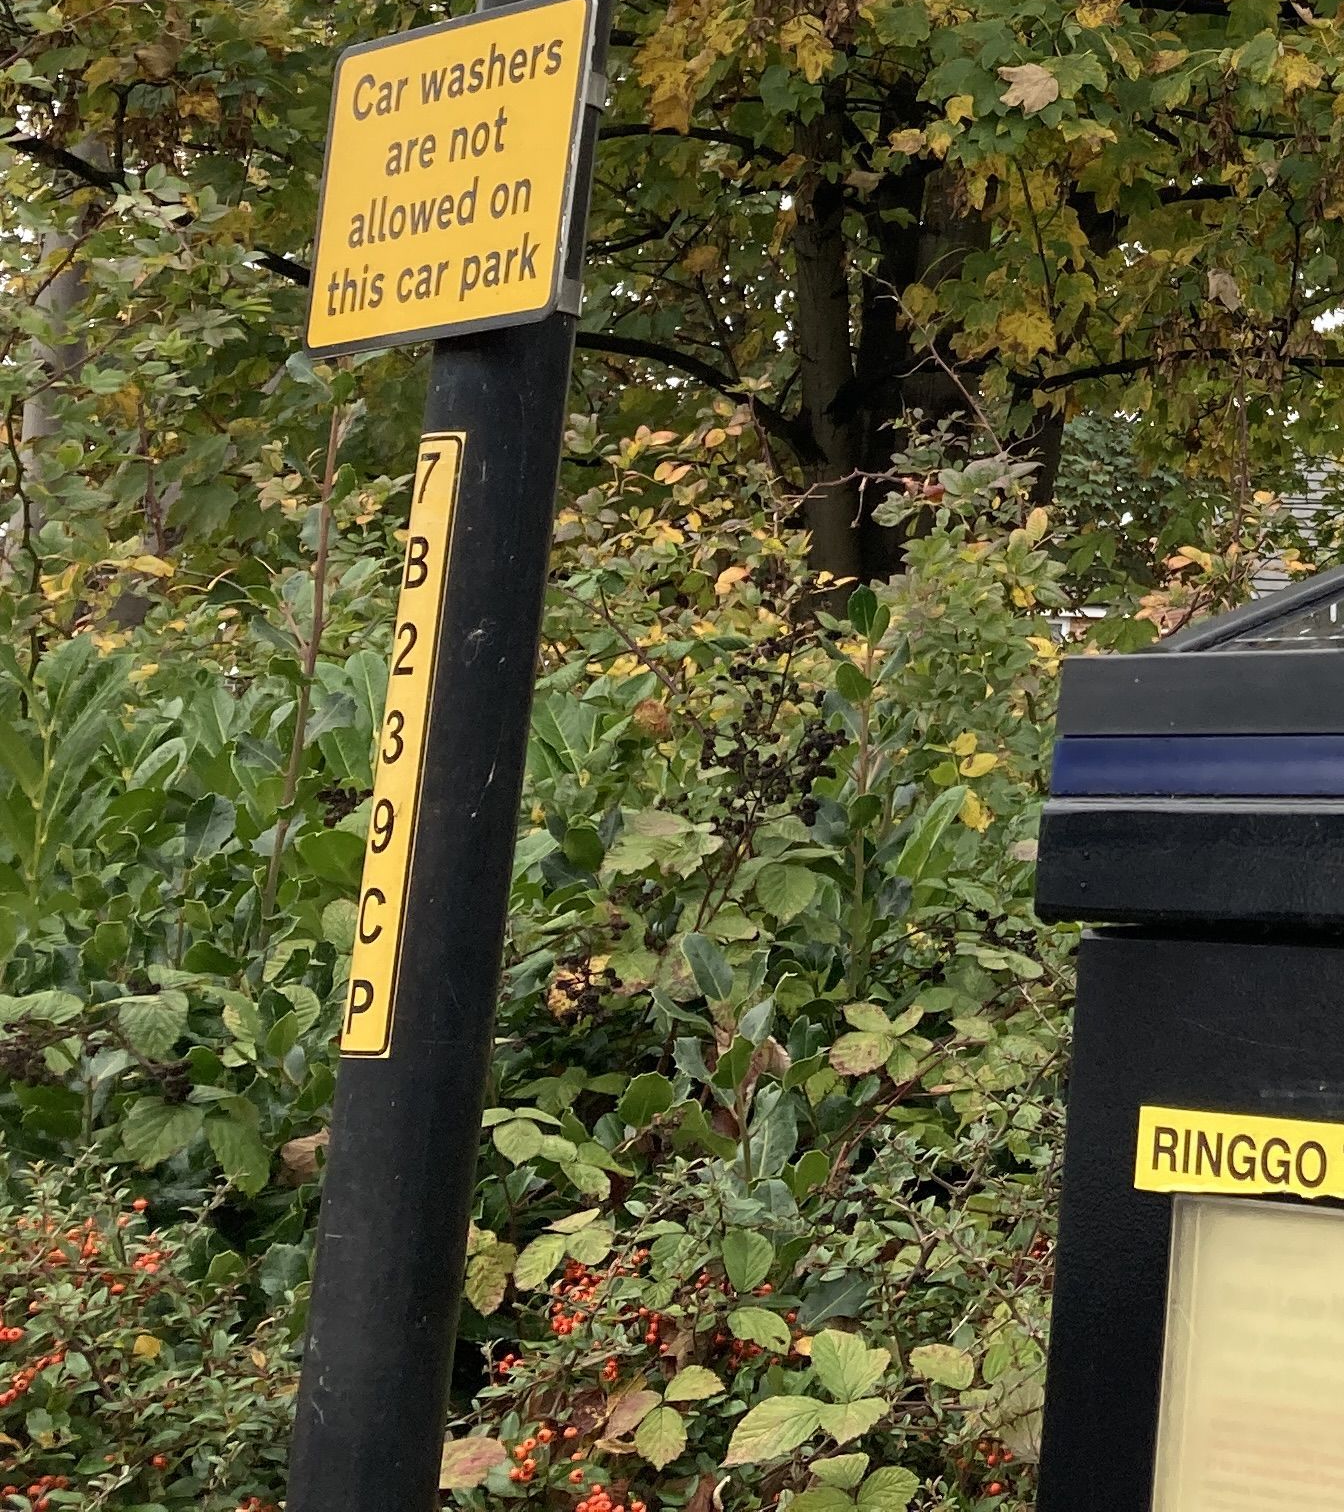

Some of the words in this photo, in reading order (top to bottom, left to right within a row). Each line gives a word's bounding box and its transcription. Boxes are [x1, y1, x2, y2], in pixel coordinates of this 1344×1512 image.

[352, 73, 409, 122] Car
[420, 38, 564, 106] washers
[385, 133, 437, 177] are
[449, 105, 508, 163] not
[347, 175, 479, 249] allowed
[490, 176, 532, 220] on
[327, 263, 385, 317] this
[396, 258, 450, 303] car
[459, 231, 541, 303] park
[1151, 1125, 1328, 1189] RINGGO
